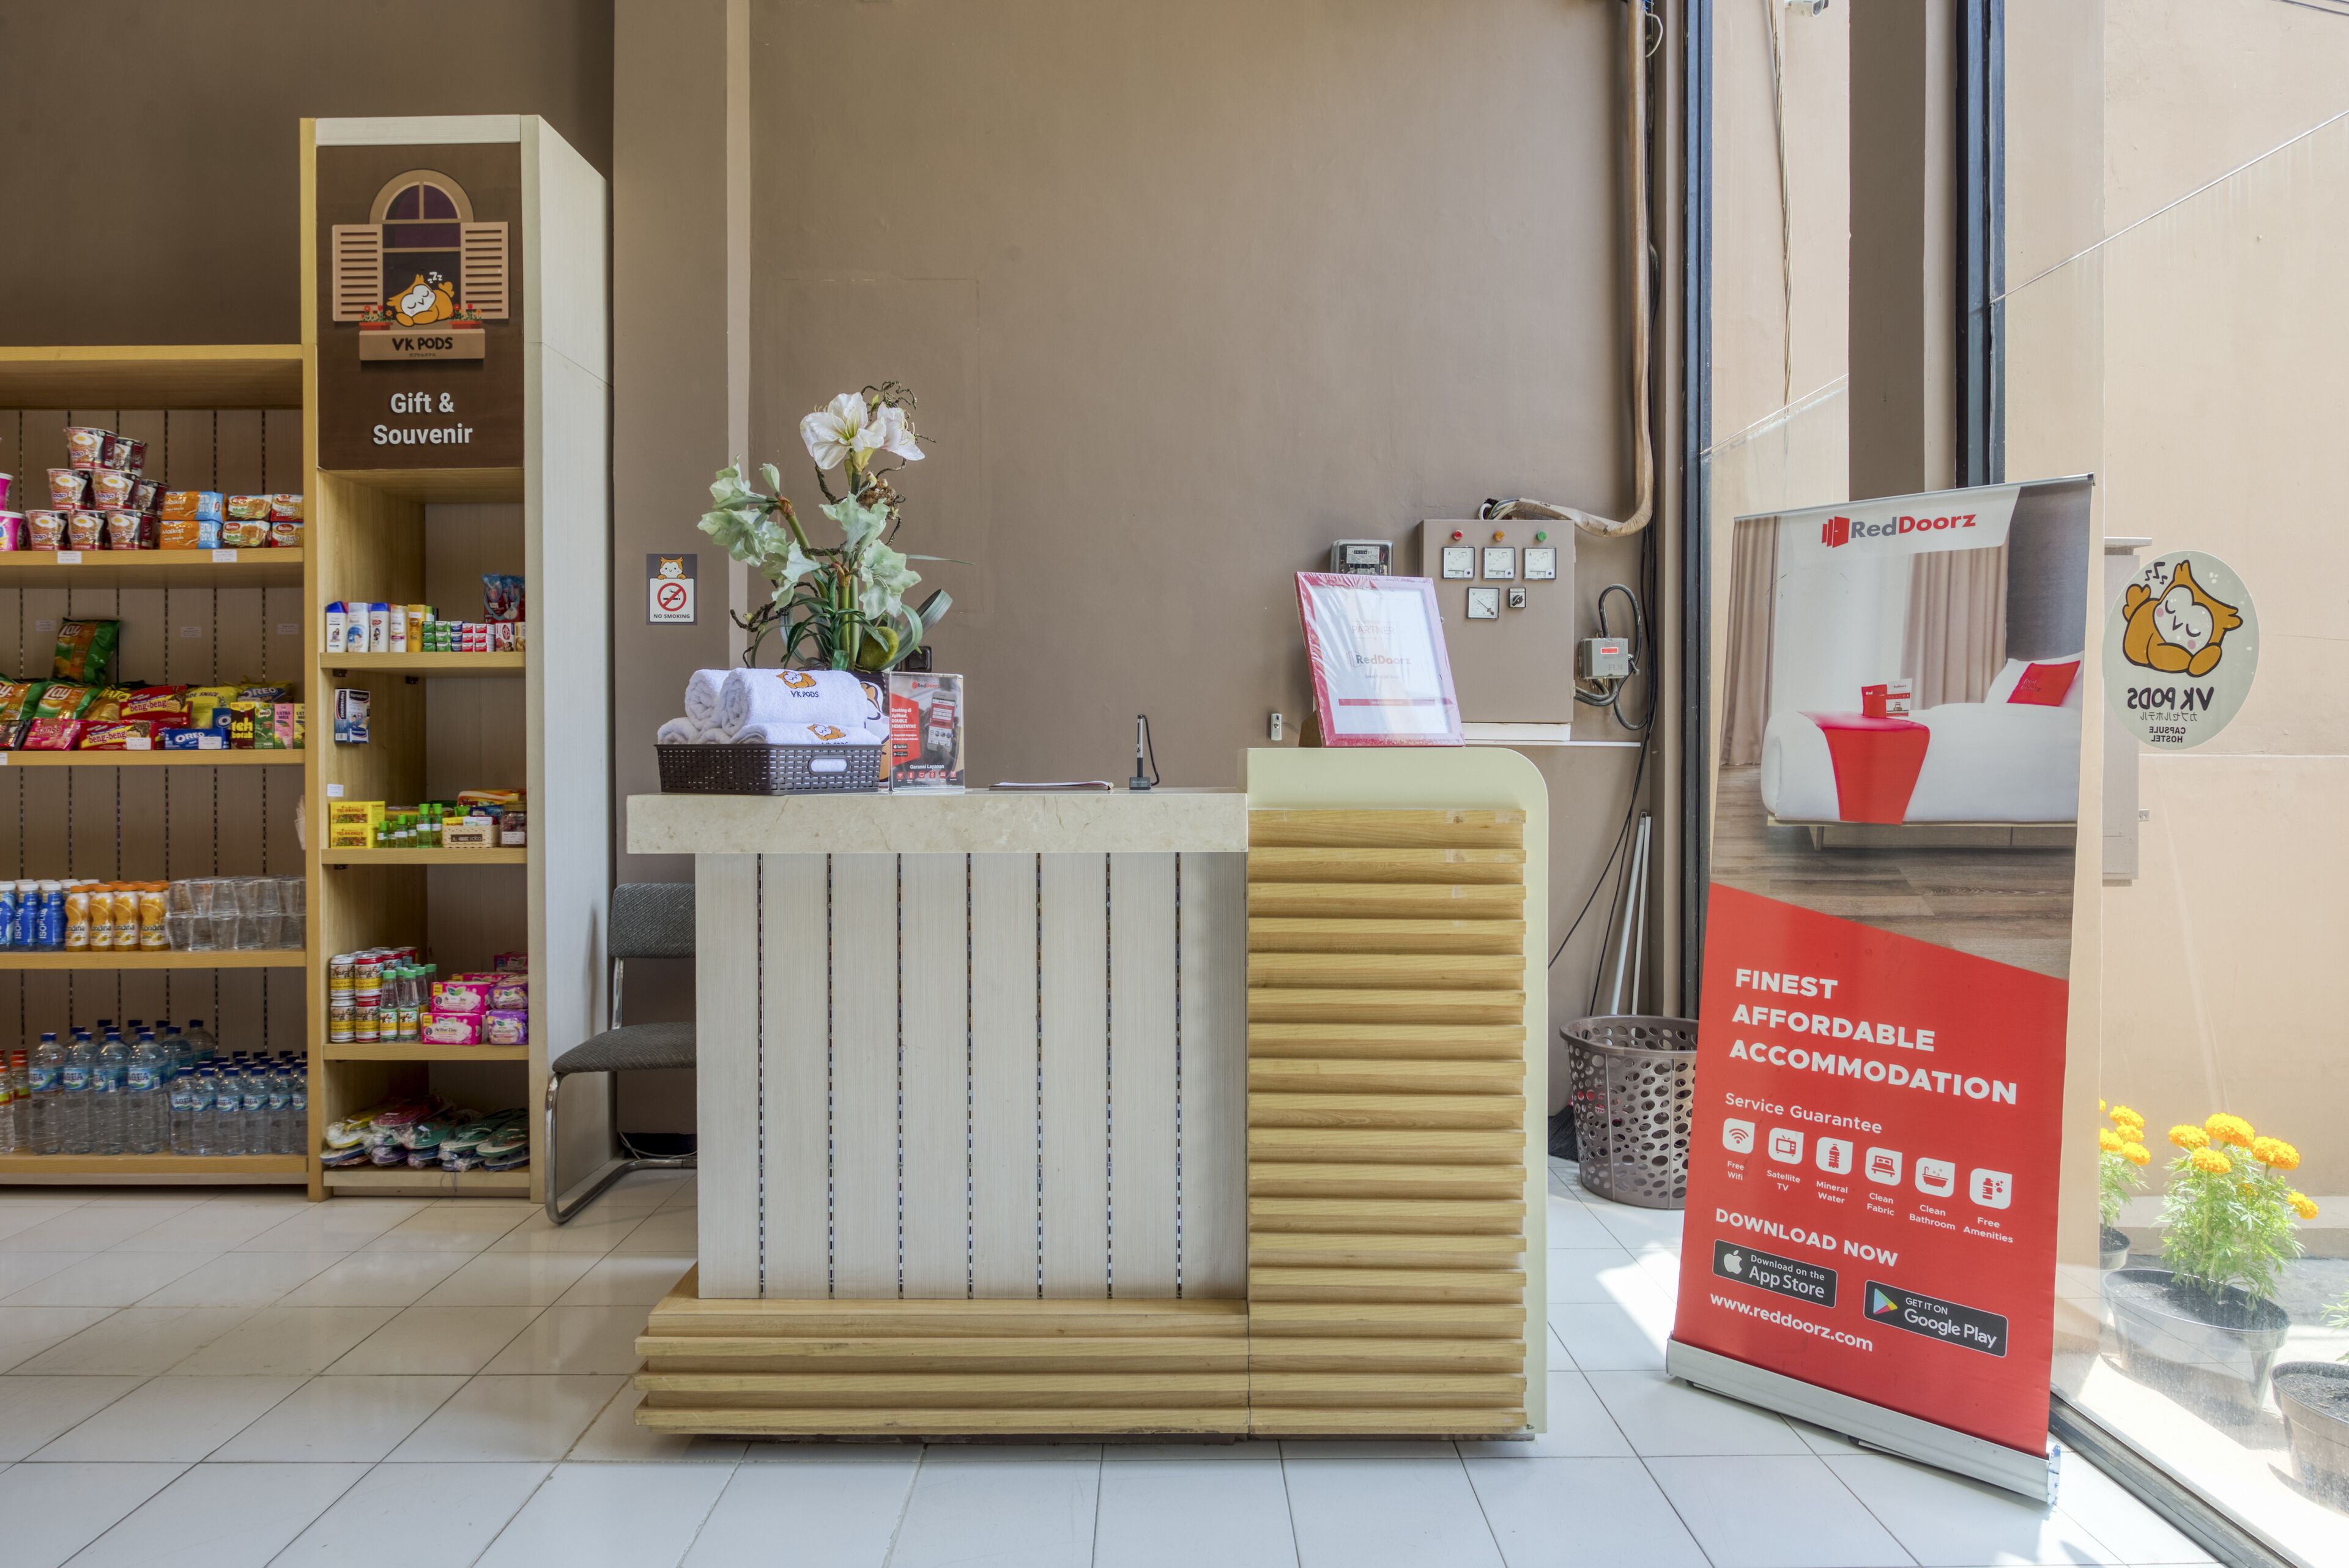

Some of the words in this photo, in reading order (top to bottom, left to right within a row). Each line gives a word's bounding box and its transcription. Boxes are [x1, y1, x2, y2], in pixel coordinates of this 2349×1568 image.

[392, 338, 414, 351] VK
[418, 337, 453, 351] PODS
[390, 392, 431, 414] Gift
[439, 393, 454, 412] &
[373, 423, 473, 445] Souvenir
[1851, 515, 1976, 538] RedDoorz
[1351, 626, 1395, 634] PARTNER
[1356, 655, 1411, 664] RedDoorz
[243, 688, 277, 699] OREO
[127, 699, 167, 713] beng-beng
[232, 717, 253, 732] teh
[86, 730, 127, 745] beng-beng
[175, 732, 206, 745] OREO
[1735, 968, 1838, 1000] FINEST
[1731, 1004, 1935, 1052] AFFORDABLE
[1729, 1039, 2017, 1105] ACCOMMODATION
[1725, 1092, 1784, 1115] Service
[1789, 1105, 1882, 1134] Guarantee
[1727, 1160, 1745, 1170] Free
[1727, 1171, 1743, 1181] Wifi
[1767, 1170, 1801, 1183] Satellite
[1776, 1183, 1789, 1191] TV
[1816, 1180, 1848, 1194] Mineral
[1817, 1191, 1846, 1204] Water
[1869, 1192, 1894, 1205] Clean
[1866, 1203, 1894, 1216] Fabric
[1920, 1204, 1946, 1216] Clean
[1909, 1213, 1956, 1230] Bathroom
[1977, 1216, 2000, 1228] Free
[1716, 1208, 1836, 1250] DOWNLOAD
[1844, 1239, 1898, 1267] NOW
[1963, 1225, 2014, 1243] Amenities
[1750, 1254, 1794, 1273] Download
[1809, 1270, 1825, 1281] the
[1748, 1266, 1780, 1287] App
[1782, 1276, 1825, 1298] Store
[1905, 1297, 1922, 1308] GET
[1923, 1301, 1932, 1310] IT
[1933, 1304, 1948, 1315] ON
[1710, 1293, 1874, 1351] www.reddoorz.com
[1904, 1309, 1961, 1336] Google
[1964, 1323, 1997, 1348] Play
